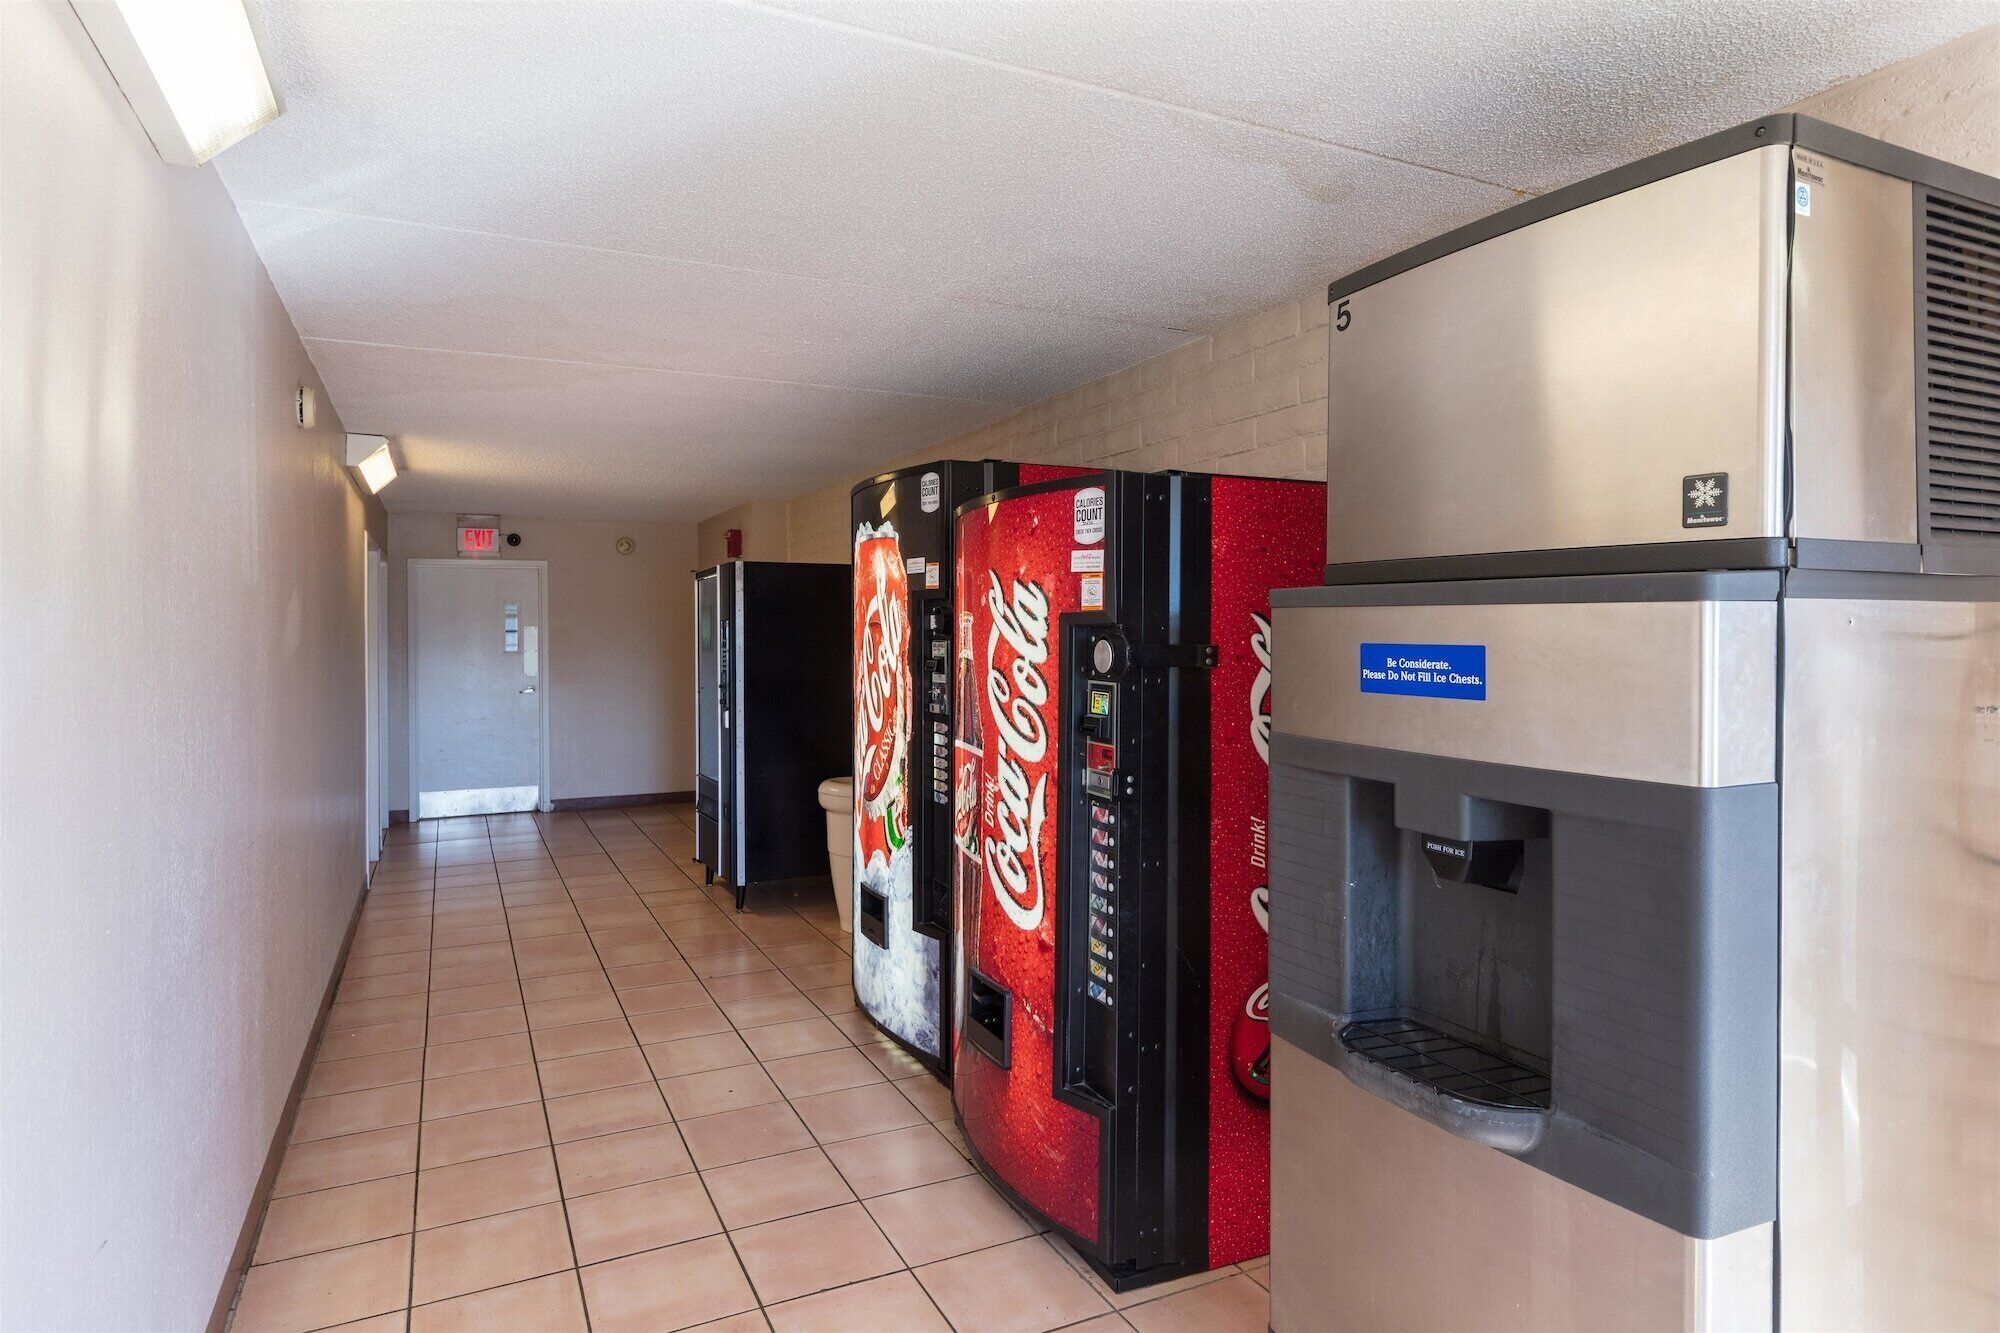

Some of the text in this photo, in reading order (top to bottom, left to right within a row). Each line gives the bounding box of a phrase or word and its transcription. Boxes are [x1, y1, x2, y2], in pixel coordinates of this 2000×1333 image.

[1337, 299, 1352, 331] 5
[922, 486, 939, 497] COUNT
[1076, 496, 1104, 509] CALORIES
[1076, 507, 1103, 522] COUNT
[1687, 515, 1723, 524] Manitowoc
[464, 529, 494, 551] EXIT
[1386, 657, 1452, 670] Be Considerate.
[1362, 669, 1483, 685] Please Do Not Fill Ice Chests.
[873, 717, 895, 781] CLASSIC
[984, 771, 997, 829] Drink!
[1250, 815, 1266, 869] Drink!
[1427, 842, 1442, 851] PUSH
[1443, 846, 1454, 854] FOR
